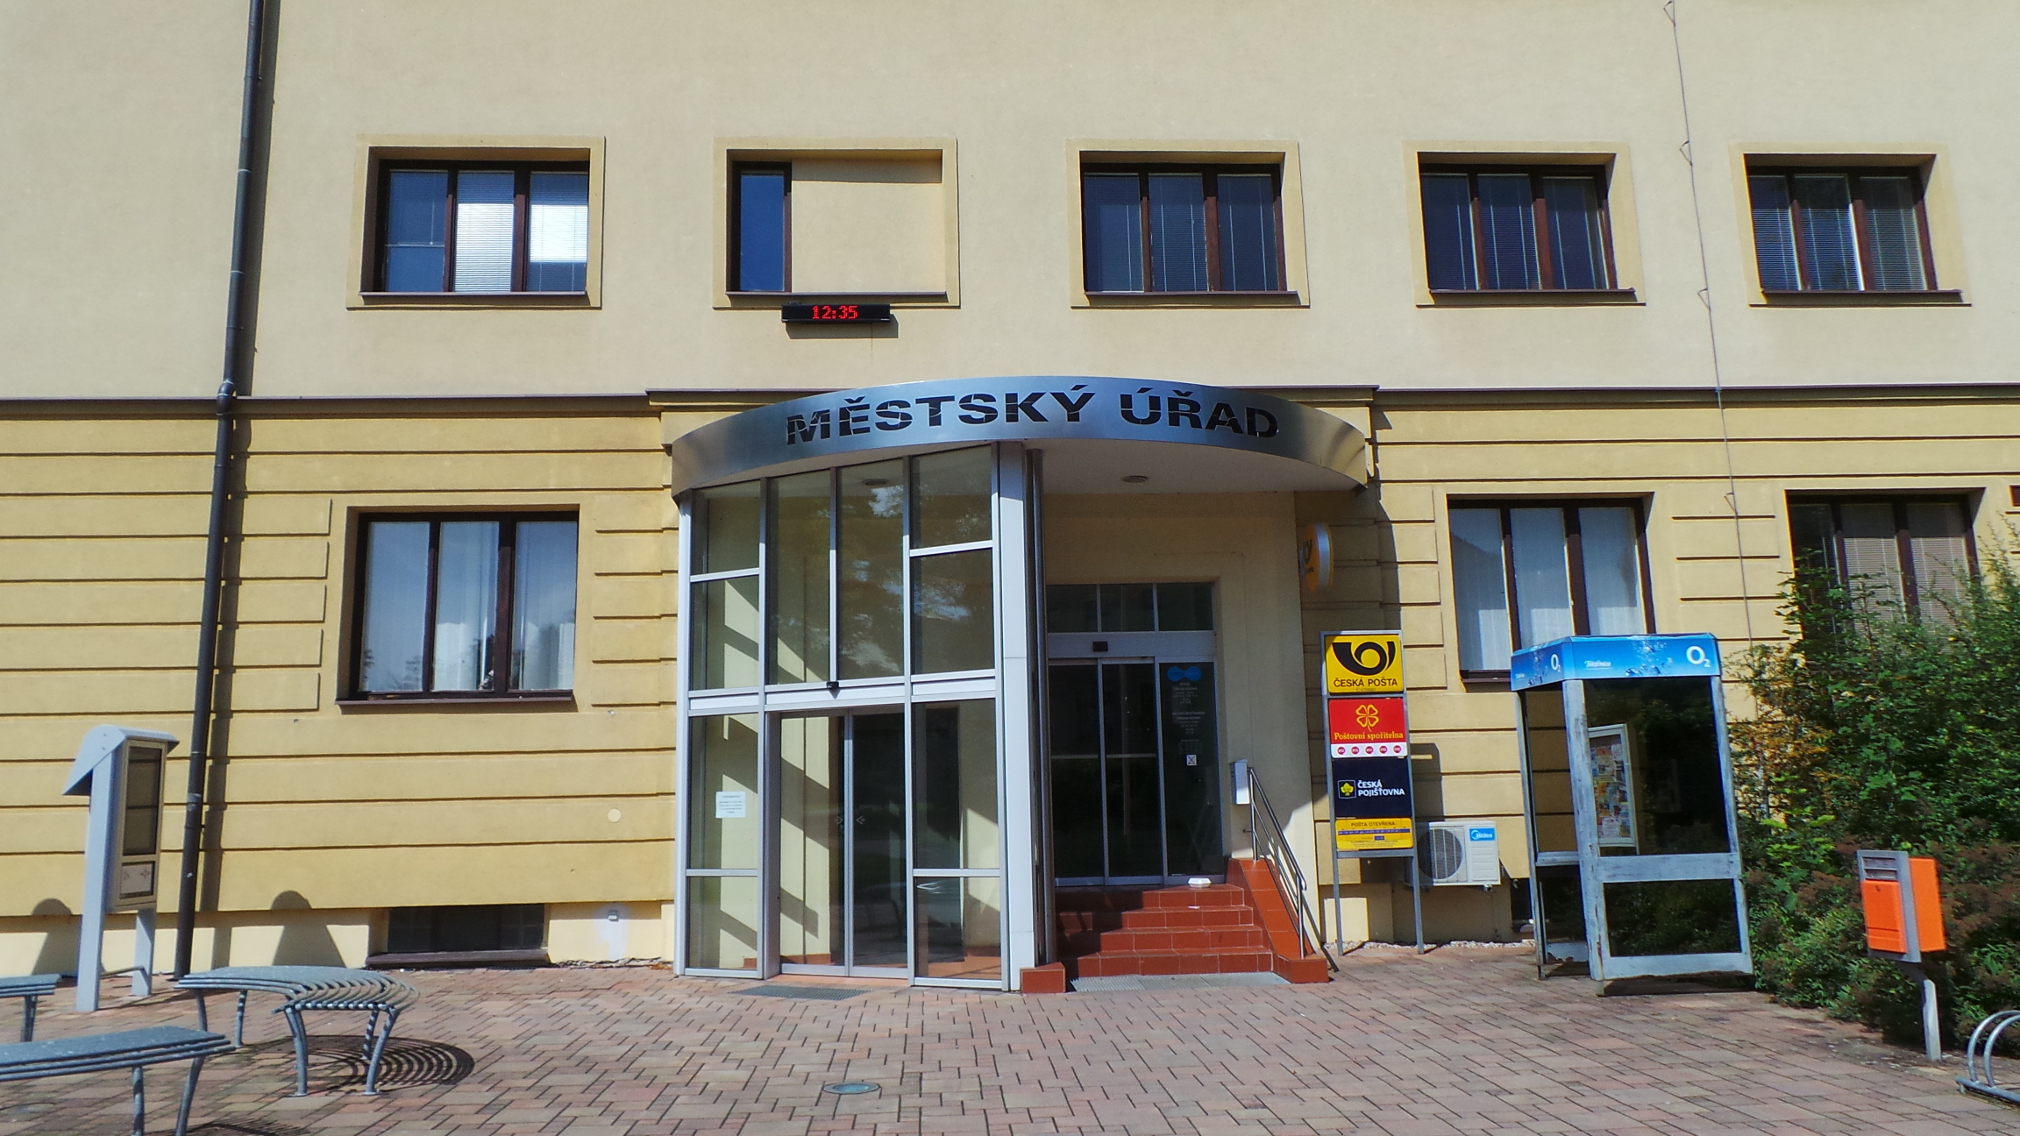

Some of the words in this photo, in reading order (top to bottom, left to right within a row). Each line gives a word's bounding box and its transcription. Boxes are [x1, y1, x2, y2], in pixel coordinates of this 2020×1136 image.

[811, 305, 859, 320] 12:35
[786, 384, 1096, 446] MĚSTSKÝ
[1119, 387, 1279, 438] ÚŘAD
[1333, 677, 1364, 687] ČESKÁ
[1367, 676, 1398, 687] POŠTA
[1334, 731, 1365, 740] Poštovní
[1367, 731, 1404, 741] spořitelna
[1357, 779, 1383, 788] ČESKÁ
[1357, 787, 1406, 797] POJIŠŤOVNA
